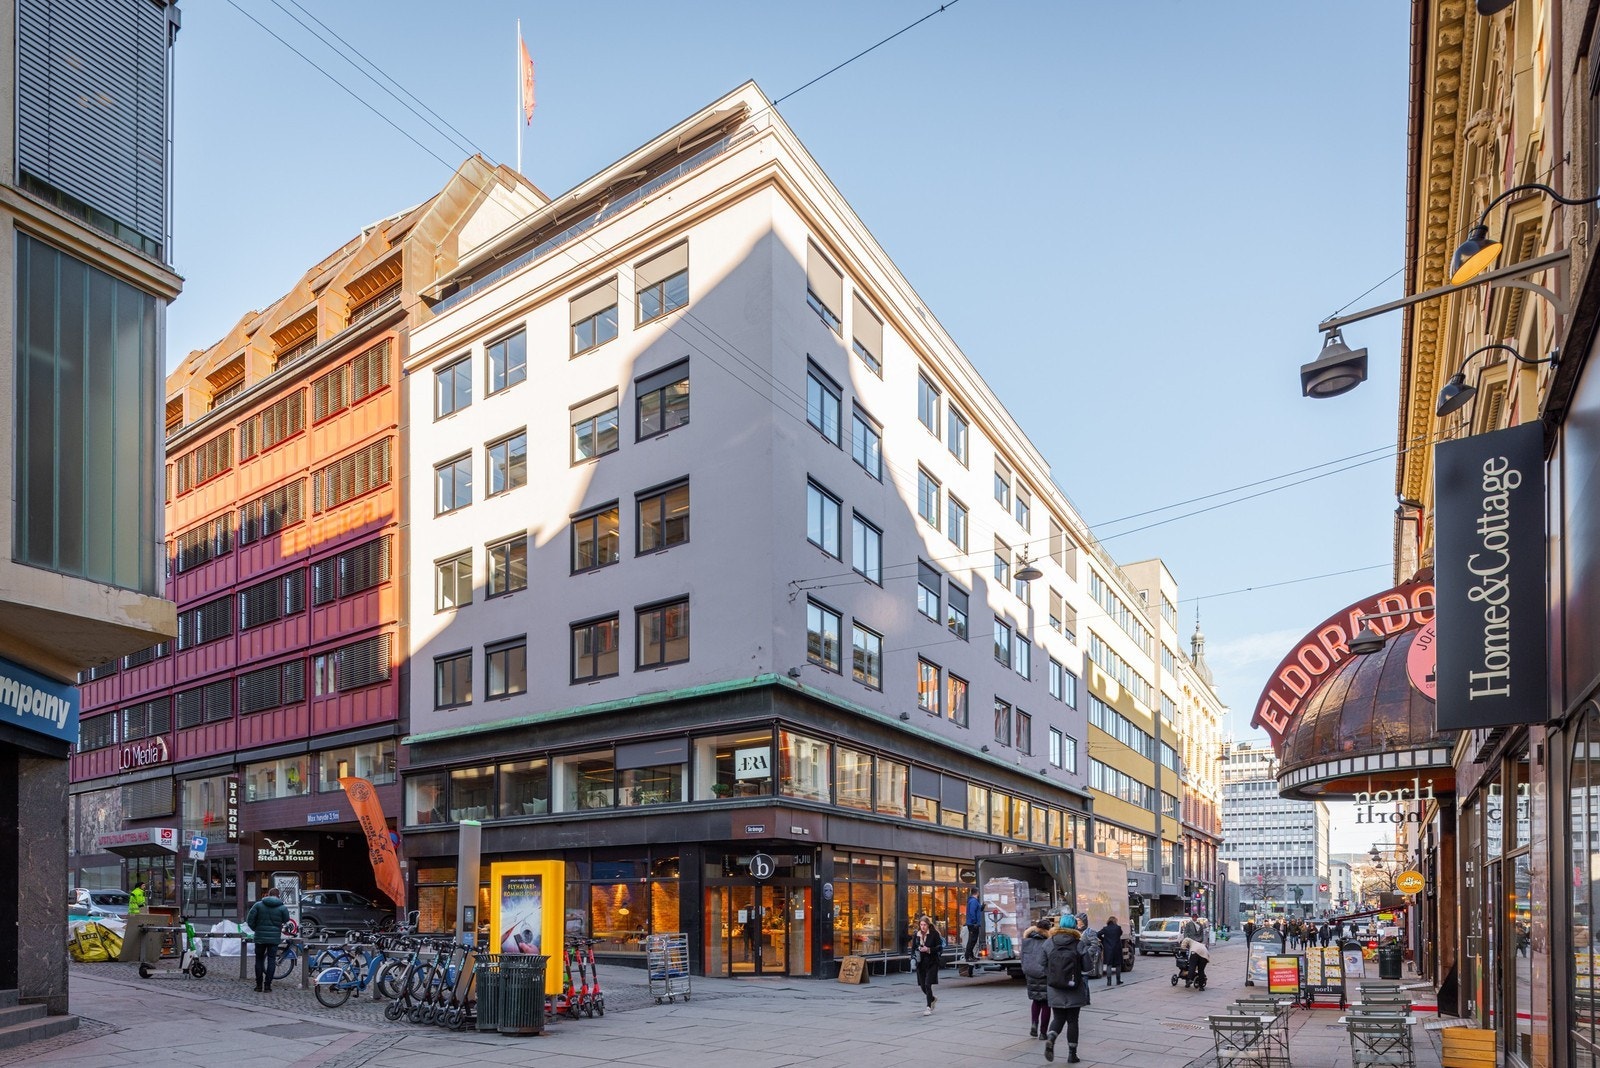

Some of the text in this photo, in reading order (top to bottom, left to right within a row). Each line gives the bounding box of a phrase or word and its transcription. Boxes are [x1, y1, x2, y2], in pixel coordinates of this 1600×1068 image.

[1467, 455, 1522, 700] Home&Cottage
[1259, 585, 1436, 735] ELDORADO
[119, 744, 158, 769] LO Media
[229, 782, 238, 839] BIG HORN
[1353, 777, 1436, 806] norli
[257, 848, 315, 857] Big Horn
